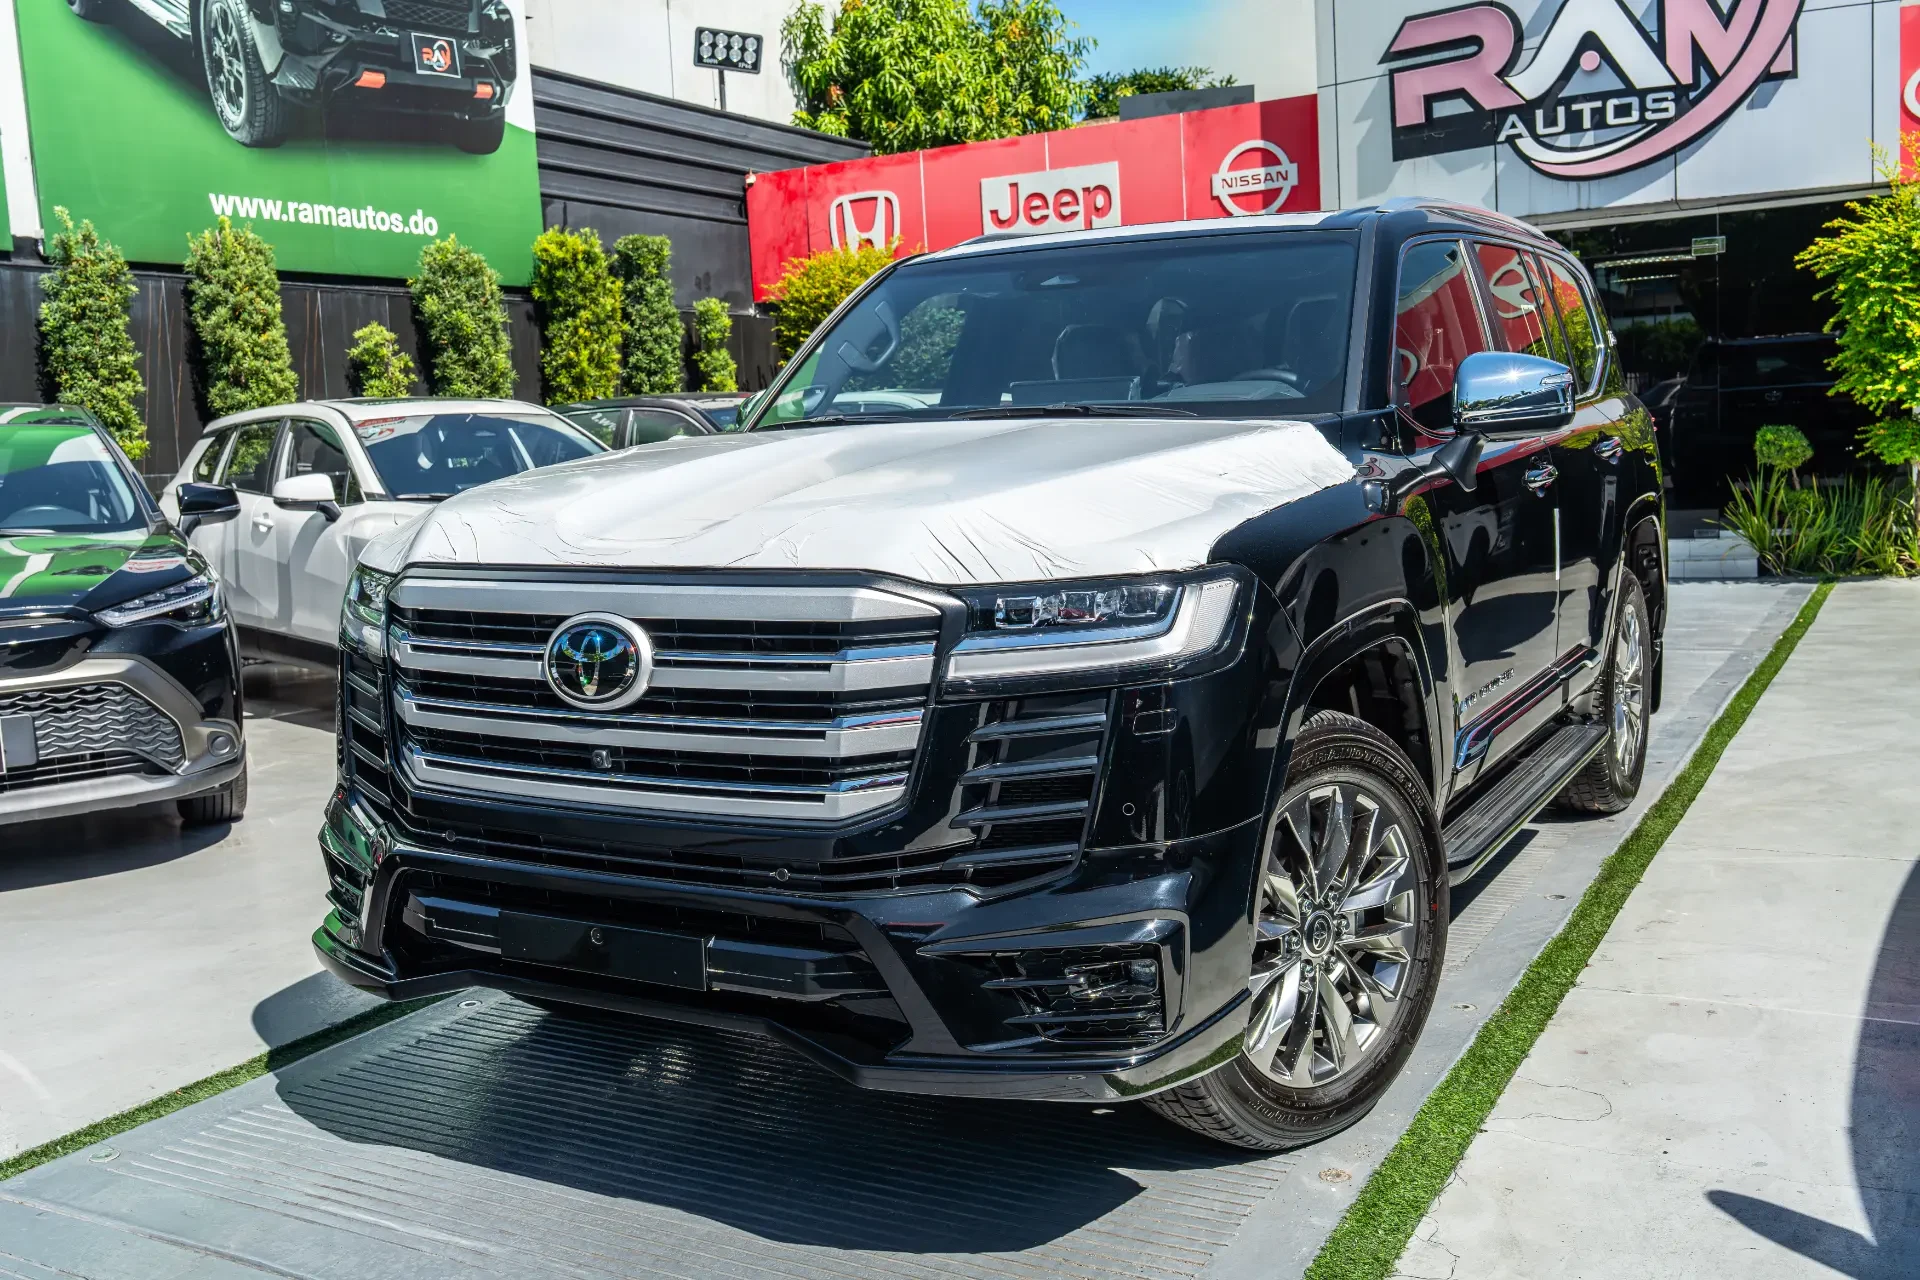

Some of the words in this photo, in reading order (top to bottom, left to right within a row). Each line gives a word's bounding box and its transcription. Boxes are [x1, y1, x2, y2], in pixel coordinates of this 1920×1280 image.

[1497, 90, 1676, 143] AUTOS
[1221, 169, 1289, 190] NISSAN
[208, 192, 439, 237] www.ramautos.do
[989, 181, 1113, 231] Jeep
